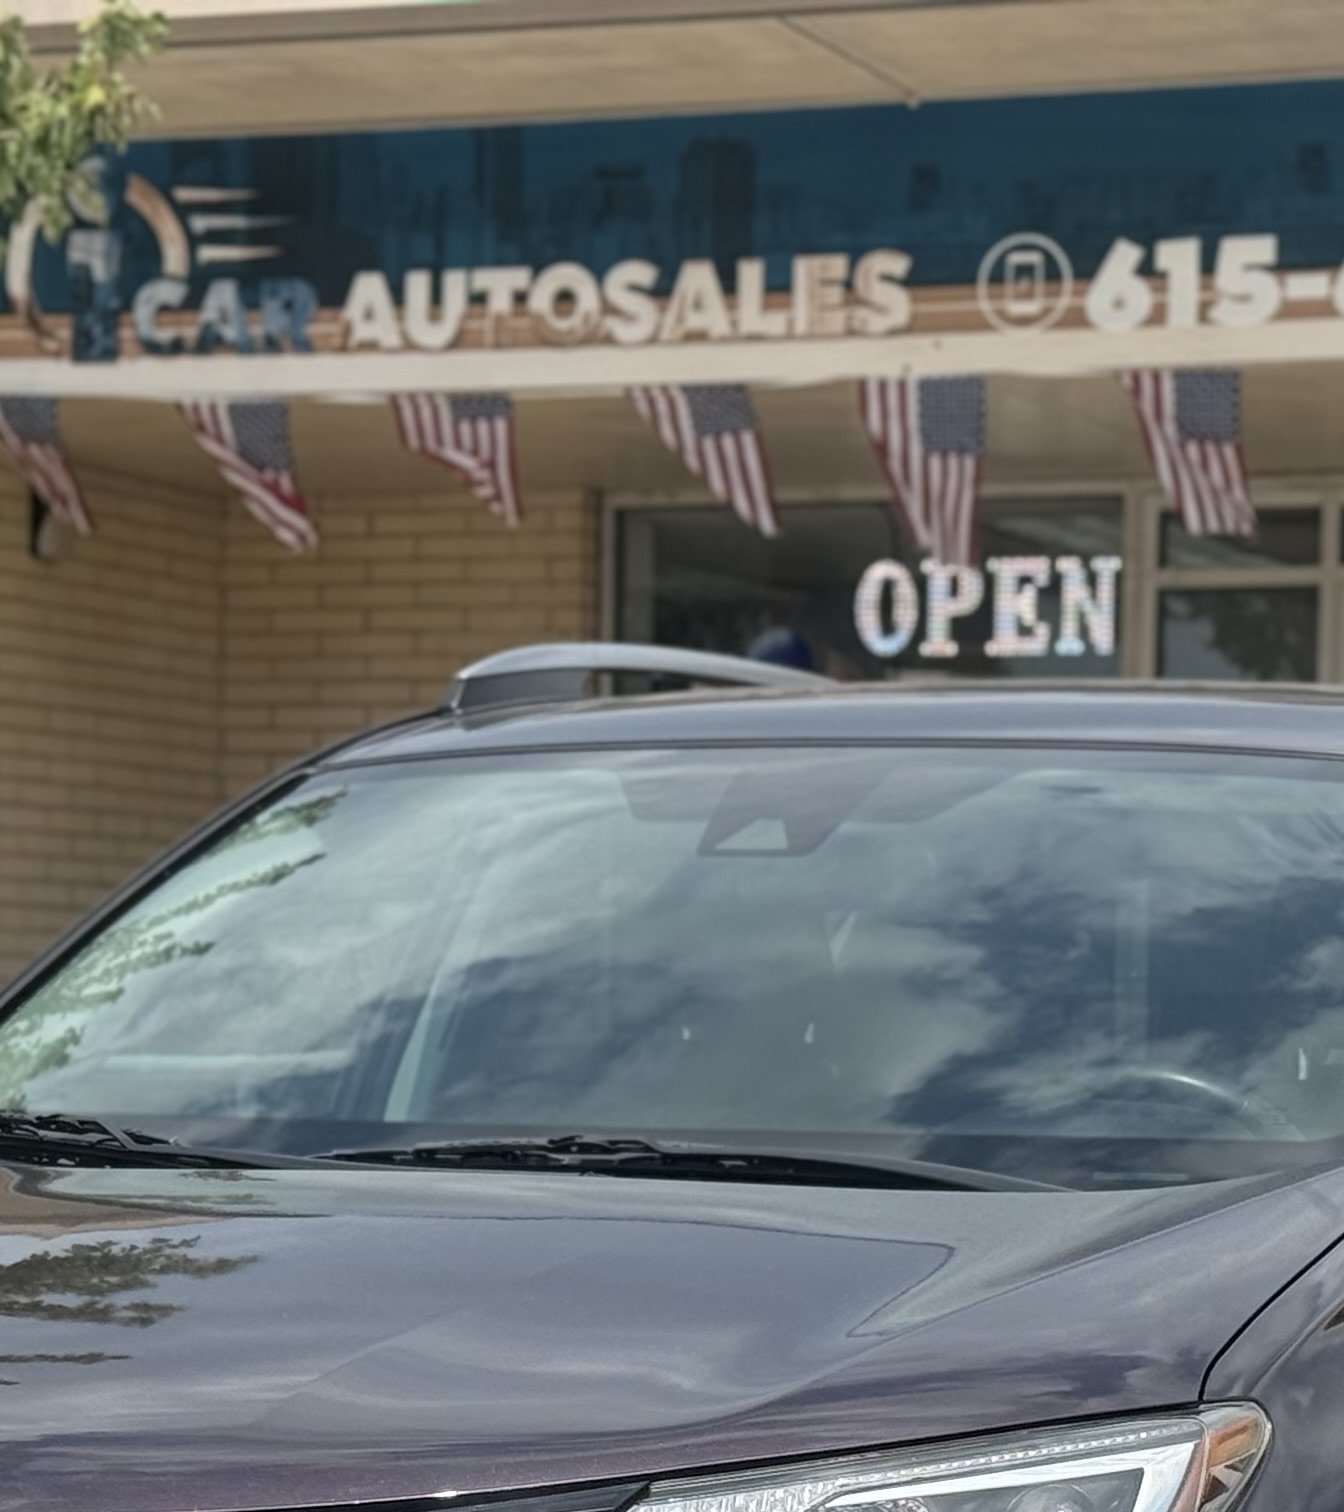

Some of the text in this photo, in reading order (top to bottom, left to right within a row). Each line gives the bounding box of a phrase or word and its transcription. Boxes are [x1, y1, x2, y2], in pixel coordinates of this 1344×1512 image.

[131, 277, 319, 354] CAR
[343, 248, 913, 351] AUTOSALES
[852, 555, 1123, 659] OPEN
